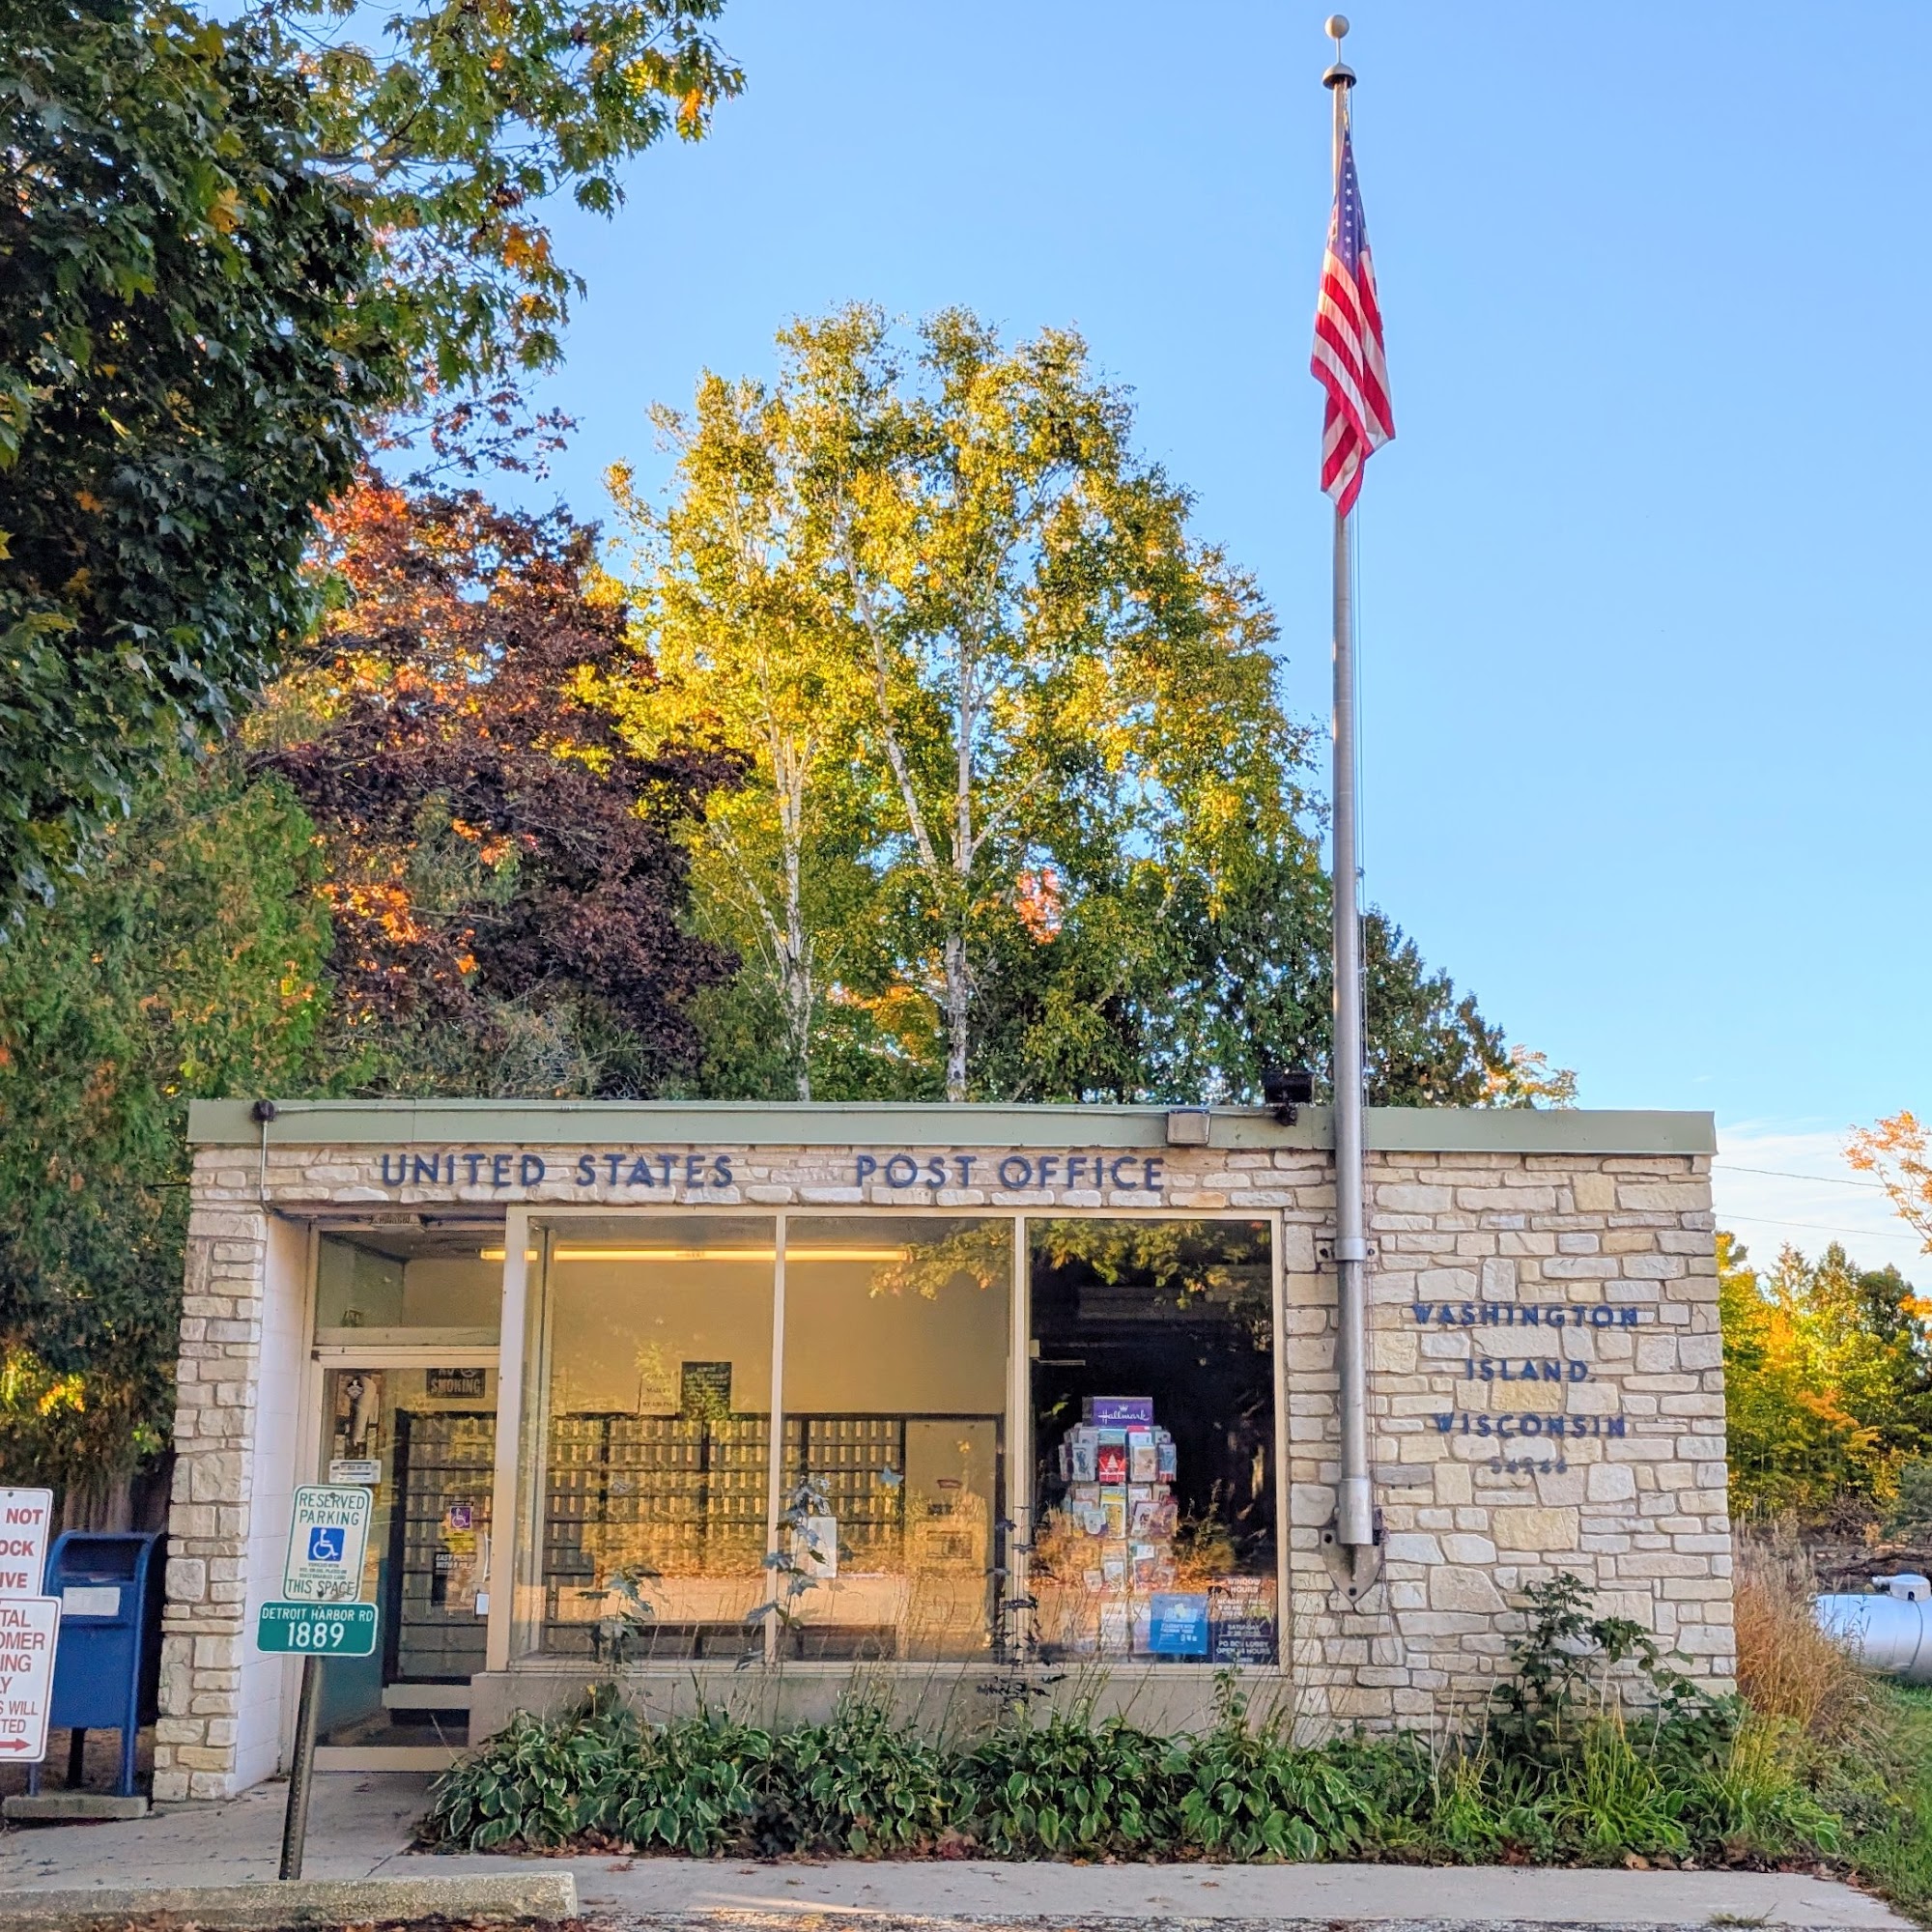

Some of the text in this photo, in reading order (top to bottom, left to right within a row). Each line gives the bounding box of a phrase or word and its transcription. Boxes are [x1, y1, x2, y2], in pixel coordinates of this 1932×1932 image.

[382, 1152, 1165, 1191] UNITED STATES POST OFFICE
[1412, 1301, 1639, 1327] WASHINGTON
[1465, 1358, 1588, 1383] ISLAND
[430, 1378, 481, 1393] SMOKING
[1097, 1409, 1150, 1425] Hallmark
[1434, 1411, 1626, 1437] WISCONSIN
[298, 1492, 366, 1510] RESERVED
[6, 1508, 43, 1525] NOT
[298, 1509, 359, 1526] PARKING
[287, 1578, 355, 1596] THIS SPACE
[1227, 1577, 1262, 1586] WINDOW
[1230, 1585, 1259, 1594] HOURS
[261, 1606, 374, 1622] DETROIT HARBOR RD
[287, 1621, 345, 1648] 1889
[9, 1700, 39, 1716] WILL
